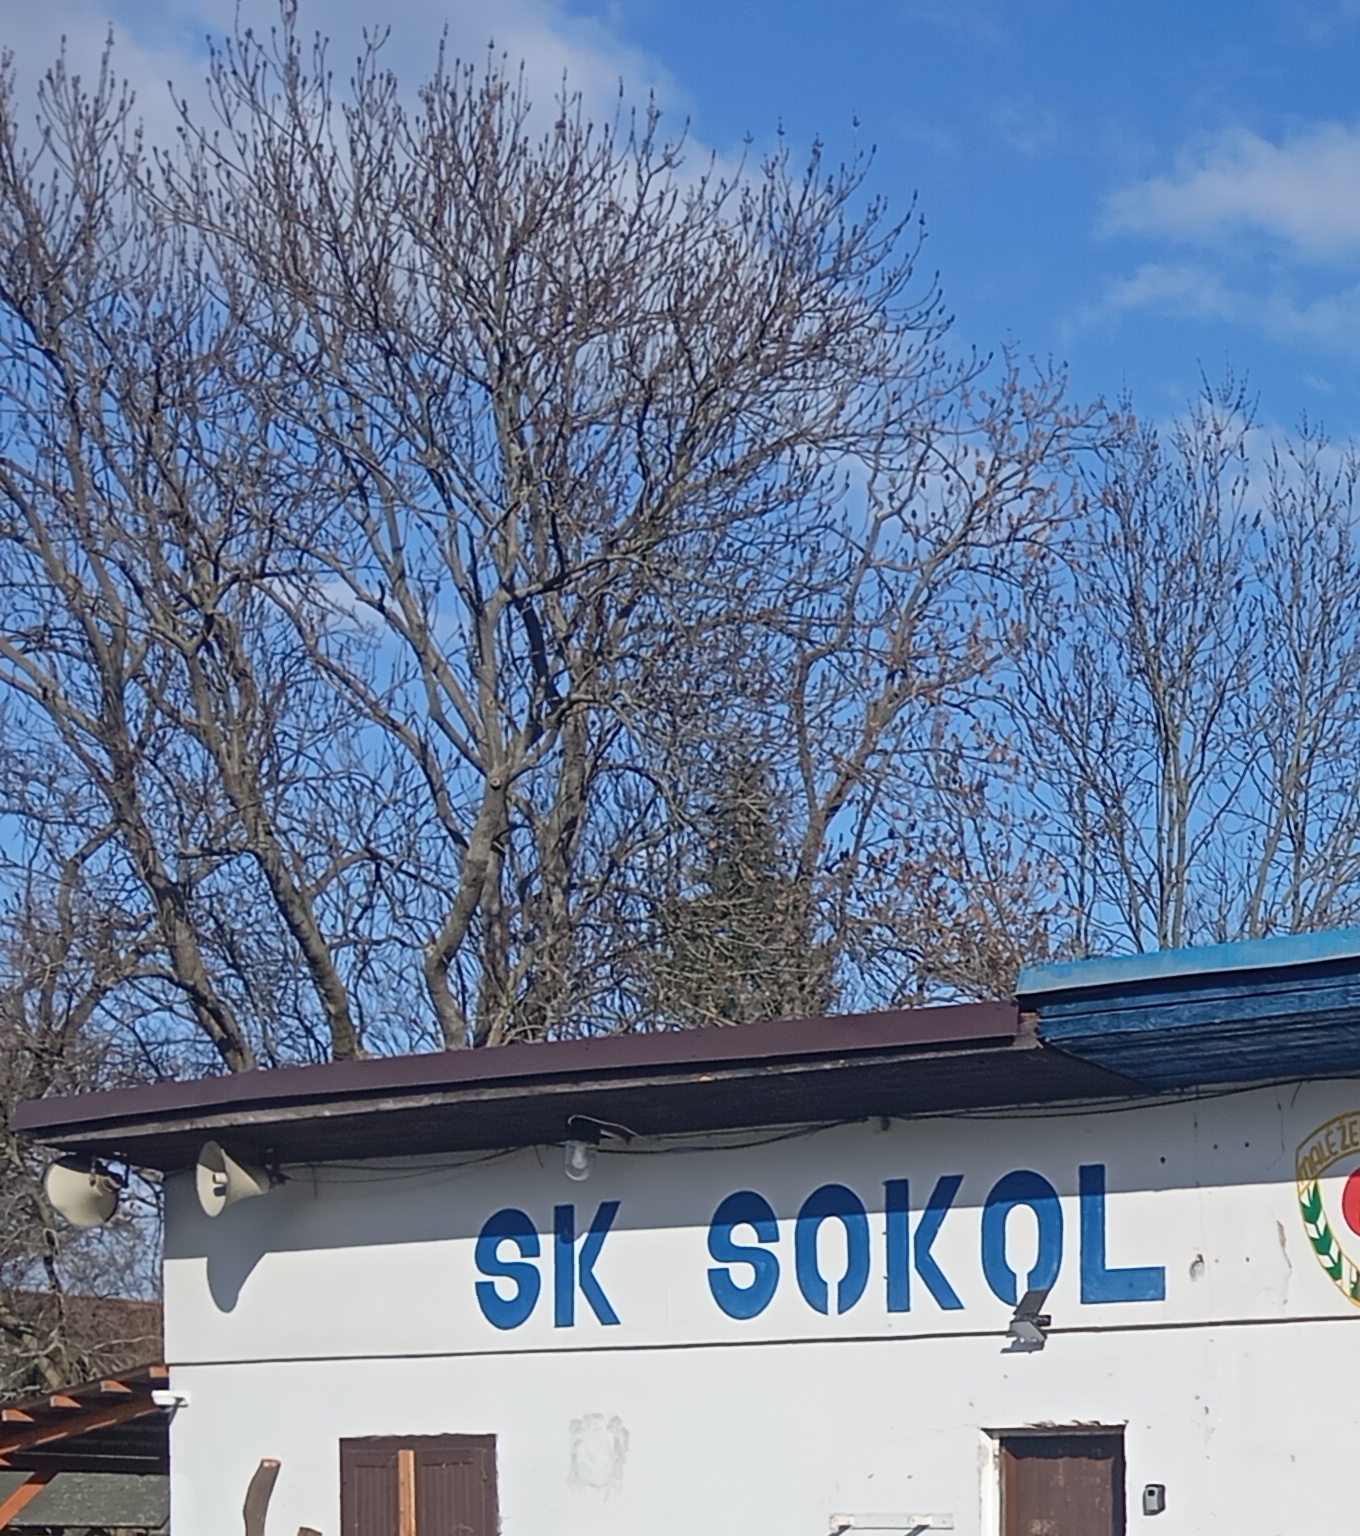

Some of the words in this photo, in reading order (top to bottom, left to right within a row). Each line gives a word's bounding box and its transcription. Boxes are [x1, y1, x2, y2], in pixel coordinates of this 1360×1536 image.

[1299, 1126, 1338, 1182] MALÉ
[474, 1201, 620, 1331] SK
[707, 1164, 1166, 1320] SOKOL
